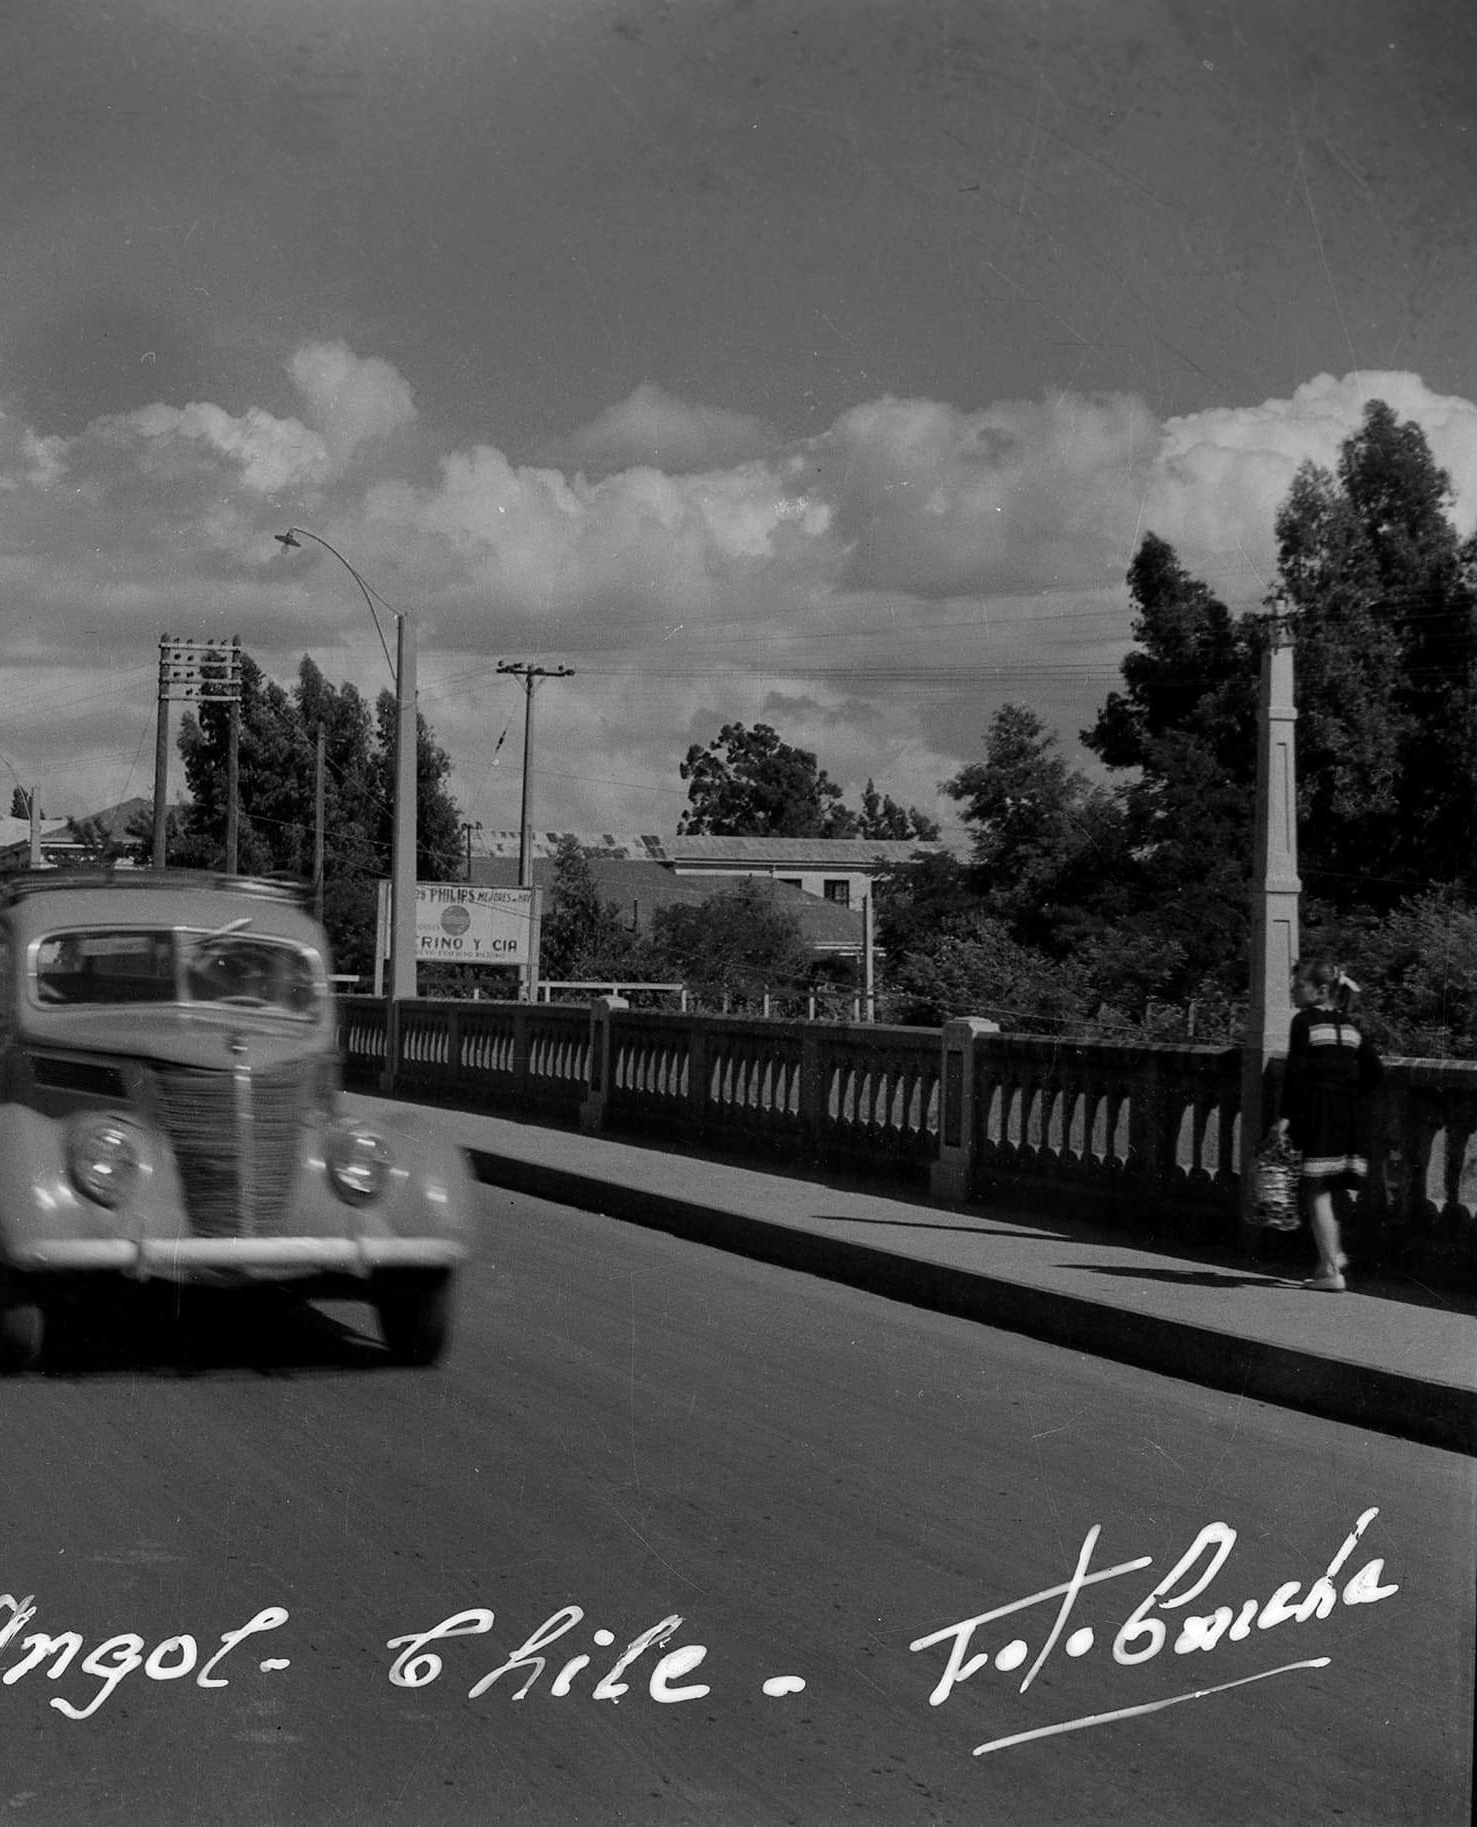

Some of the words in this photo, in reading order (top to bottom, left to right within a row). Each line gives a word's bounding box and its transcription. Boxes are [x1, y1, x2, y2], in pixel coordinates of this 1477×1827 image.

[430, 888, 475, 904] PHILIPS
[417, 936, 464, 950] RINO
[473, 938, 482, 951] Y
[492, 939, 517, 952] CIA
